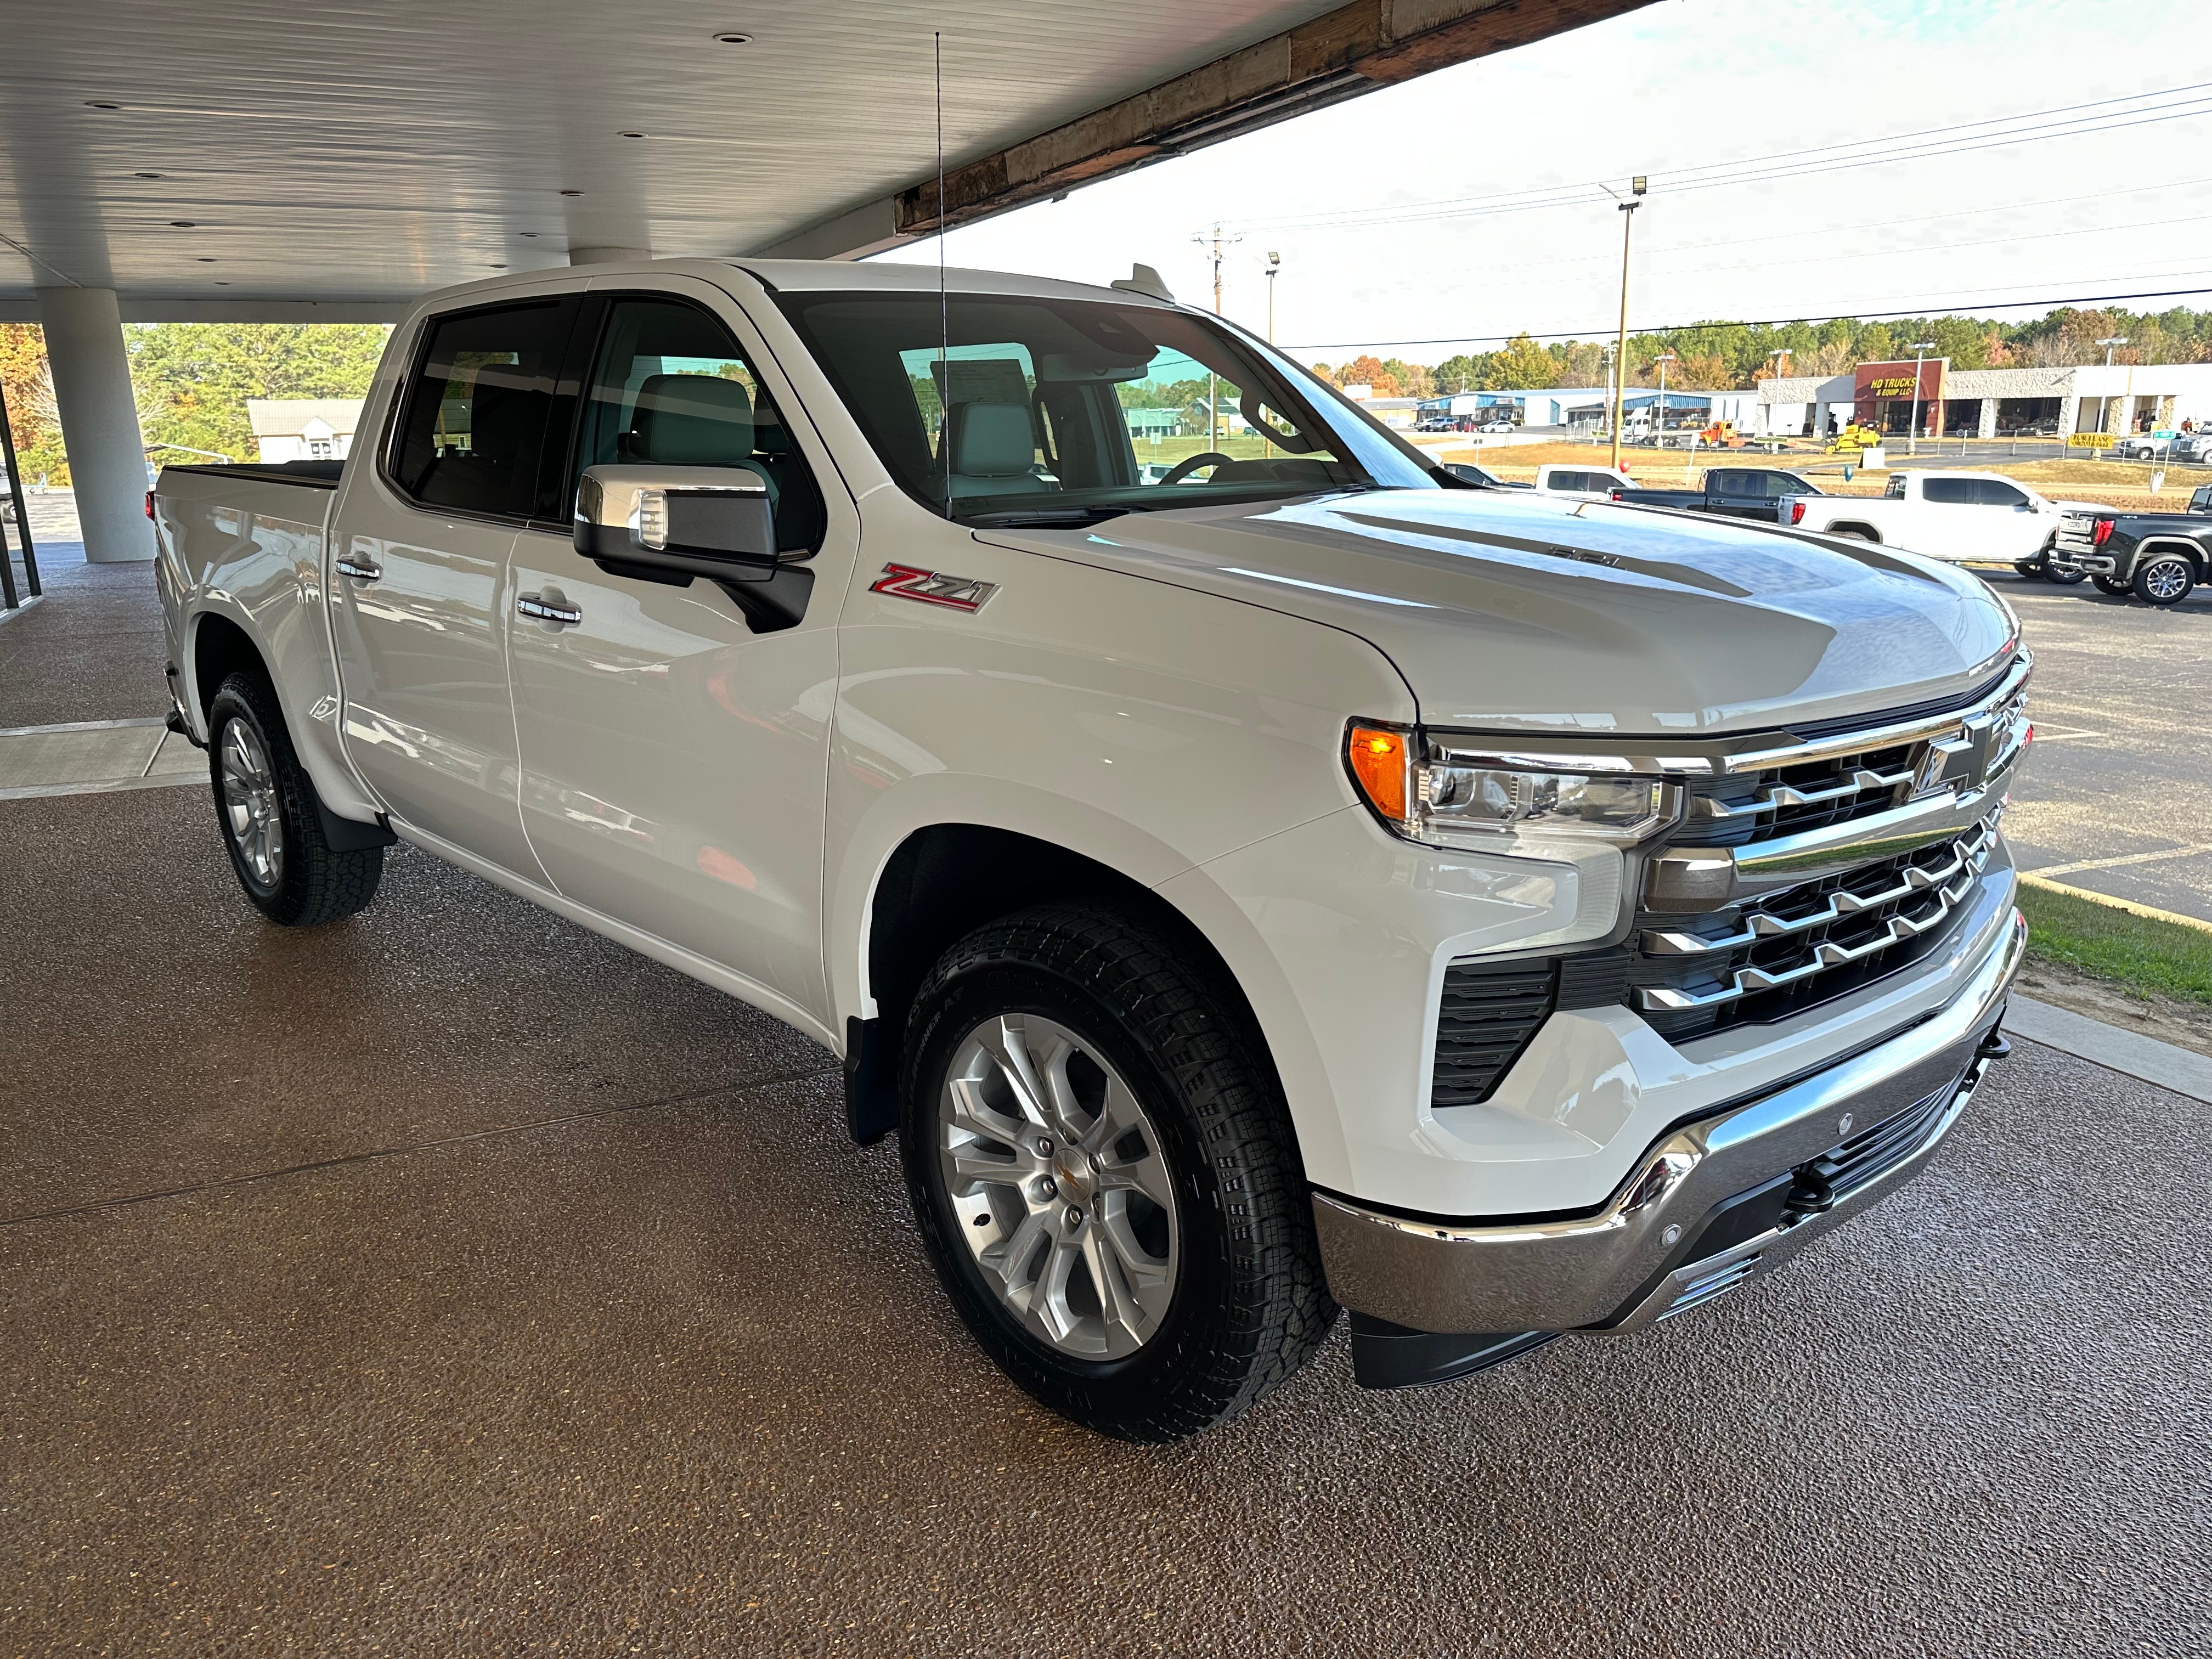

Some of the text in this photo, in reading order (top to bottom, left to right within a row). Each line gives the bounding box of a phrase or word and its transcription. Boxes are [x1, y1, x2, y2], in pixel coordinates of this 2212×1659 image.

[1871, 377, 1917, 389] HD TRUCKS
[868, 562, 1003, 616] Z71
